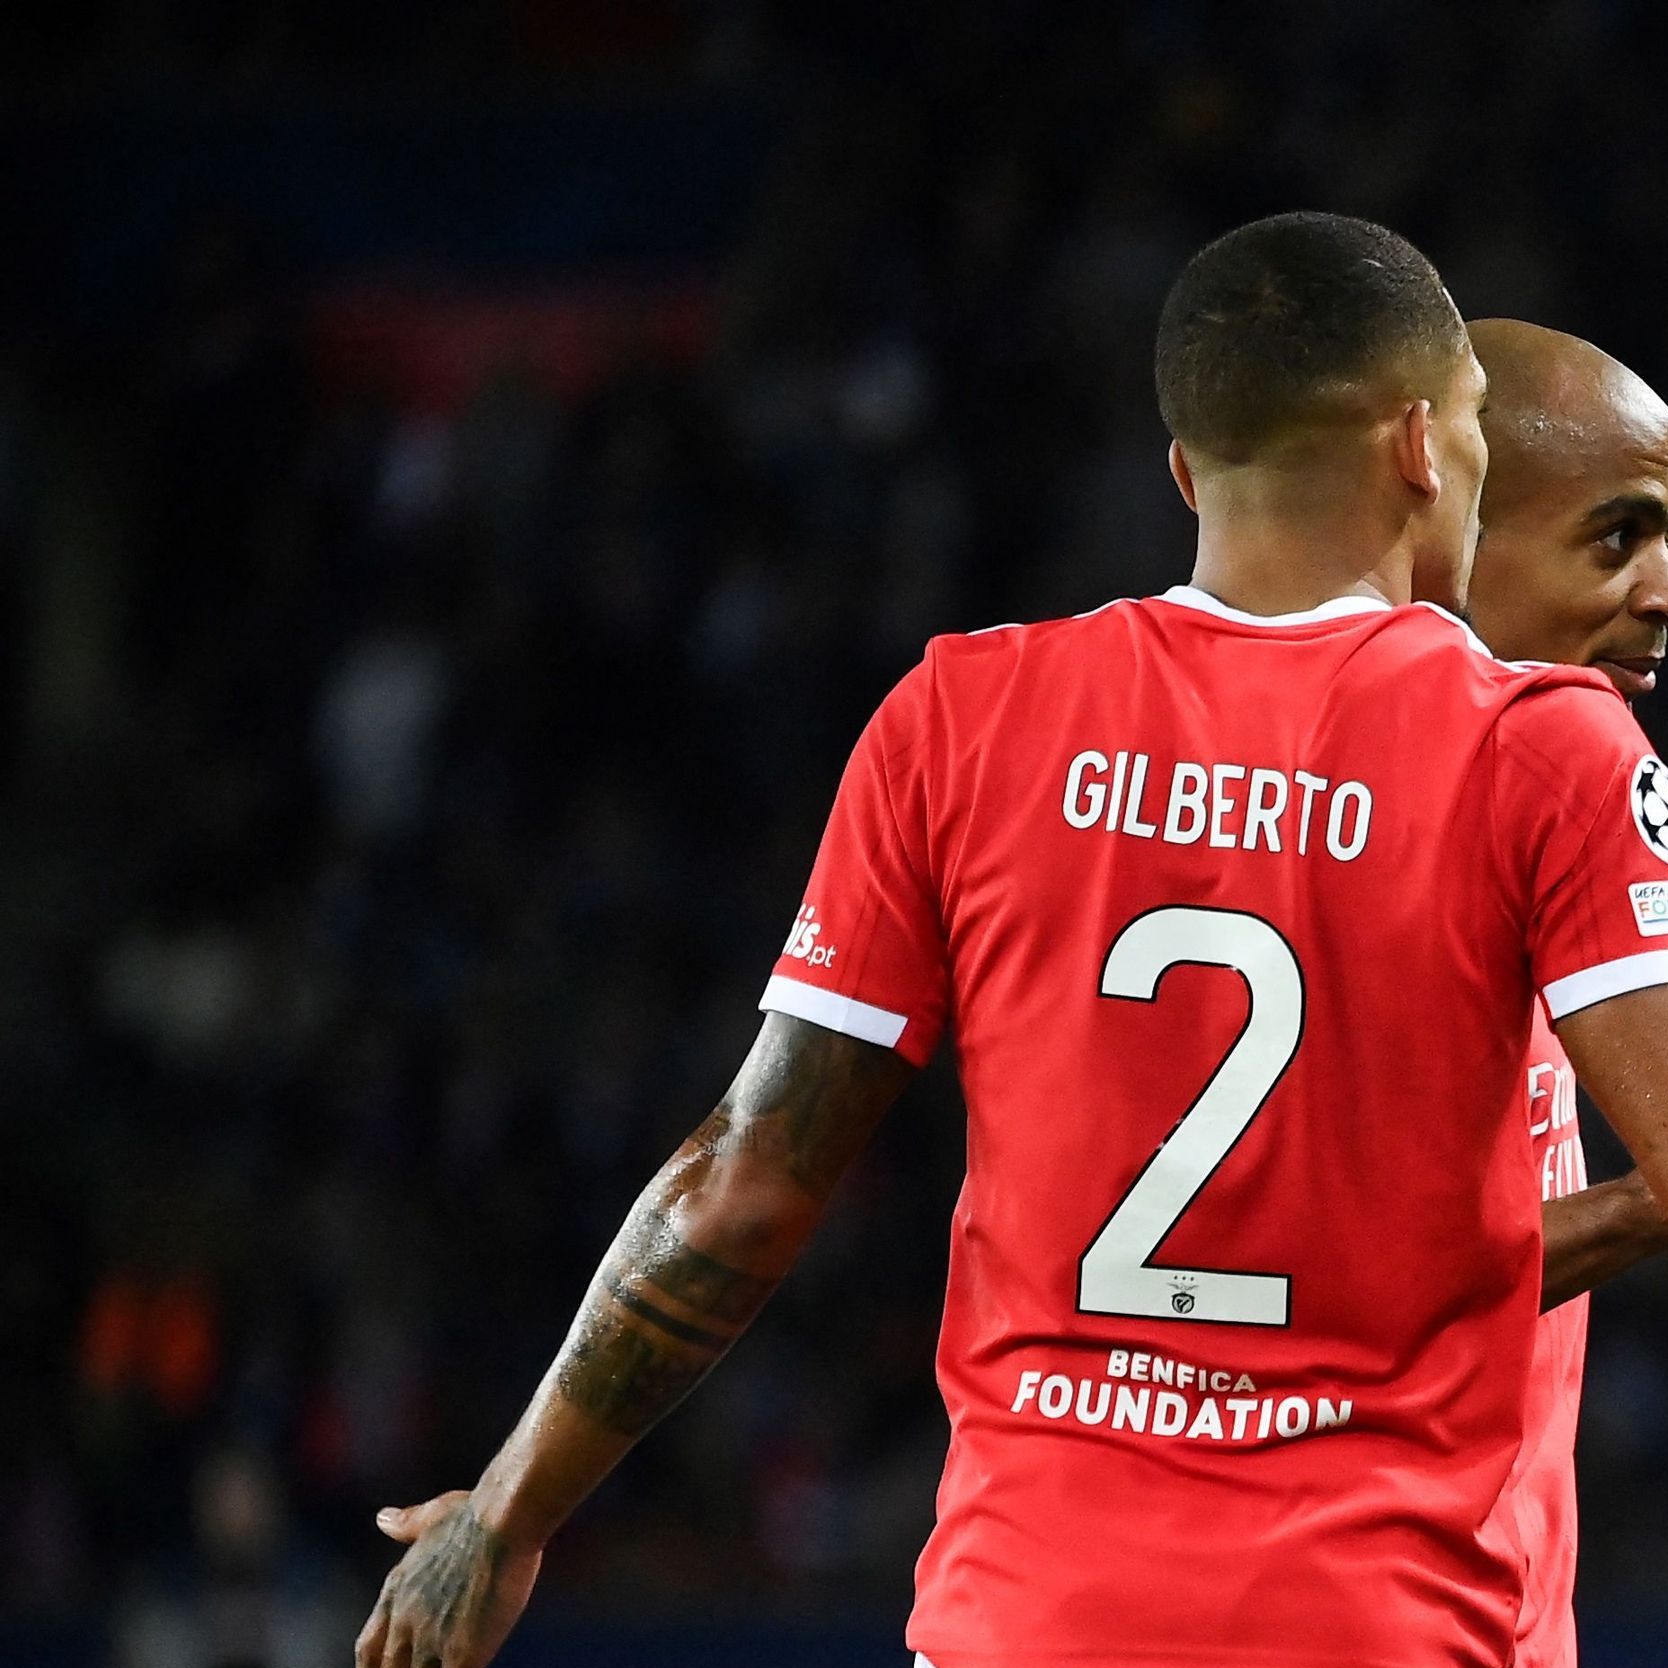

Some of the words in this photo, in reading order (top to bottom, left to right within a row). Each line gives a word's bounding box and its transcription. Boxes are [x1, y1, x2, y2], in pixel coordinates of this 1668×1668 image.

[1062, 750, 1374, 862] GILBERTO
[1076, 903, 1305, 1326] 2
[1010, 1371, 1353, 1440] FOUNDATION
[1107, 1349, 1256, 1392] BENFICA
